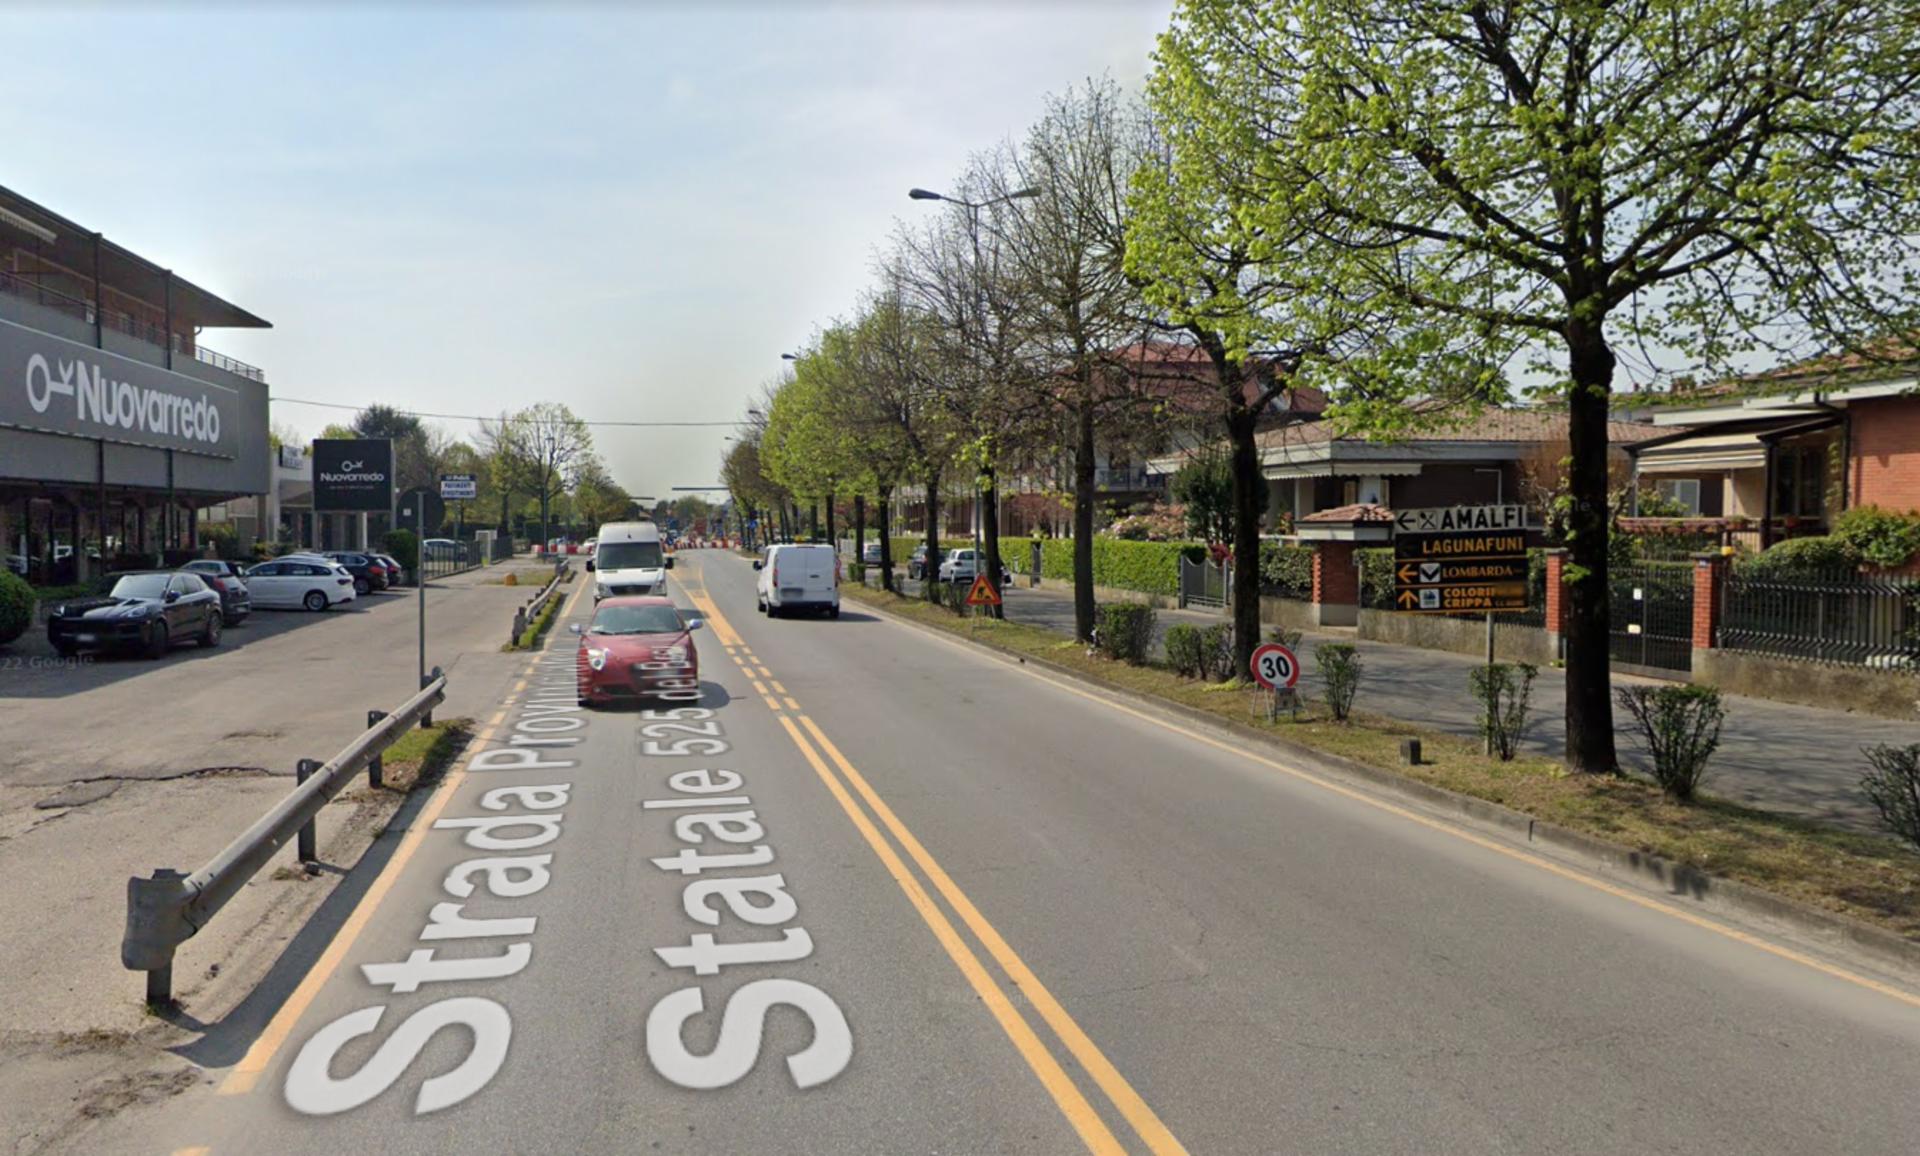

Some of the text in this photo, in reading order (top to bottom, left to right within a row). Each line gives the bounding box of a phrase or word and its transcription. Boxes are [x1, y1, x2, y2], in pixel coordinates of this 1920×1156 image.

[76, 359, 220, 444] Nuovarredo
[320, 472, 384, 482] Nuovarredo
[1441, 506, 1523, 530] AMALFI
[1422, 536, 1523, 554] LAGUNAFUNI
[1442, 565, 1513, 578] LOMBARDA
[1443, 598, 1492, 608] CRIPPA
[1262, 655, 1290, 679] 30
